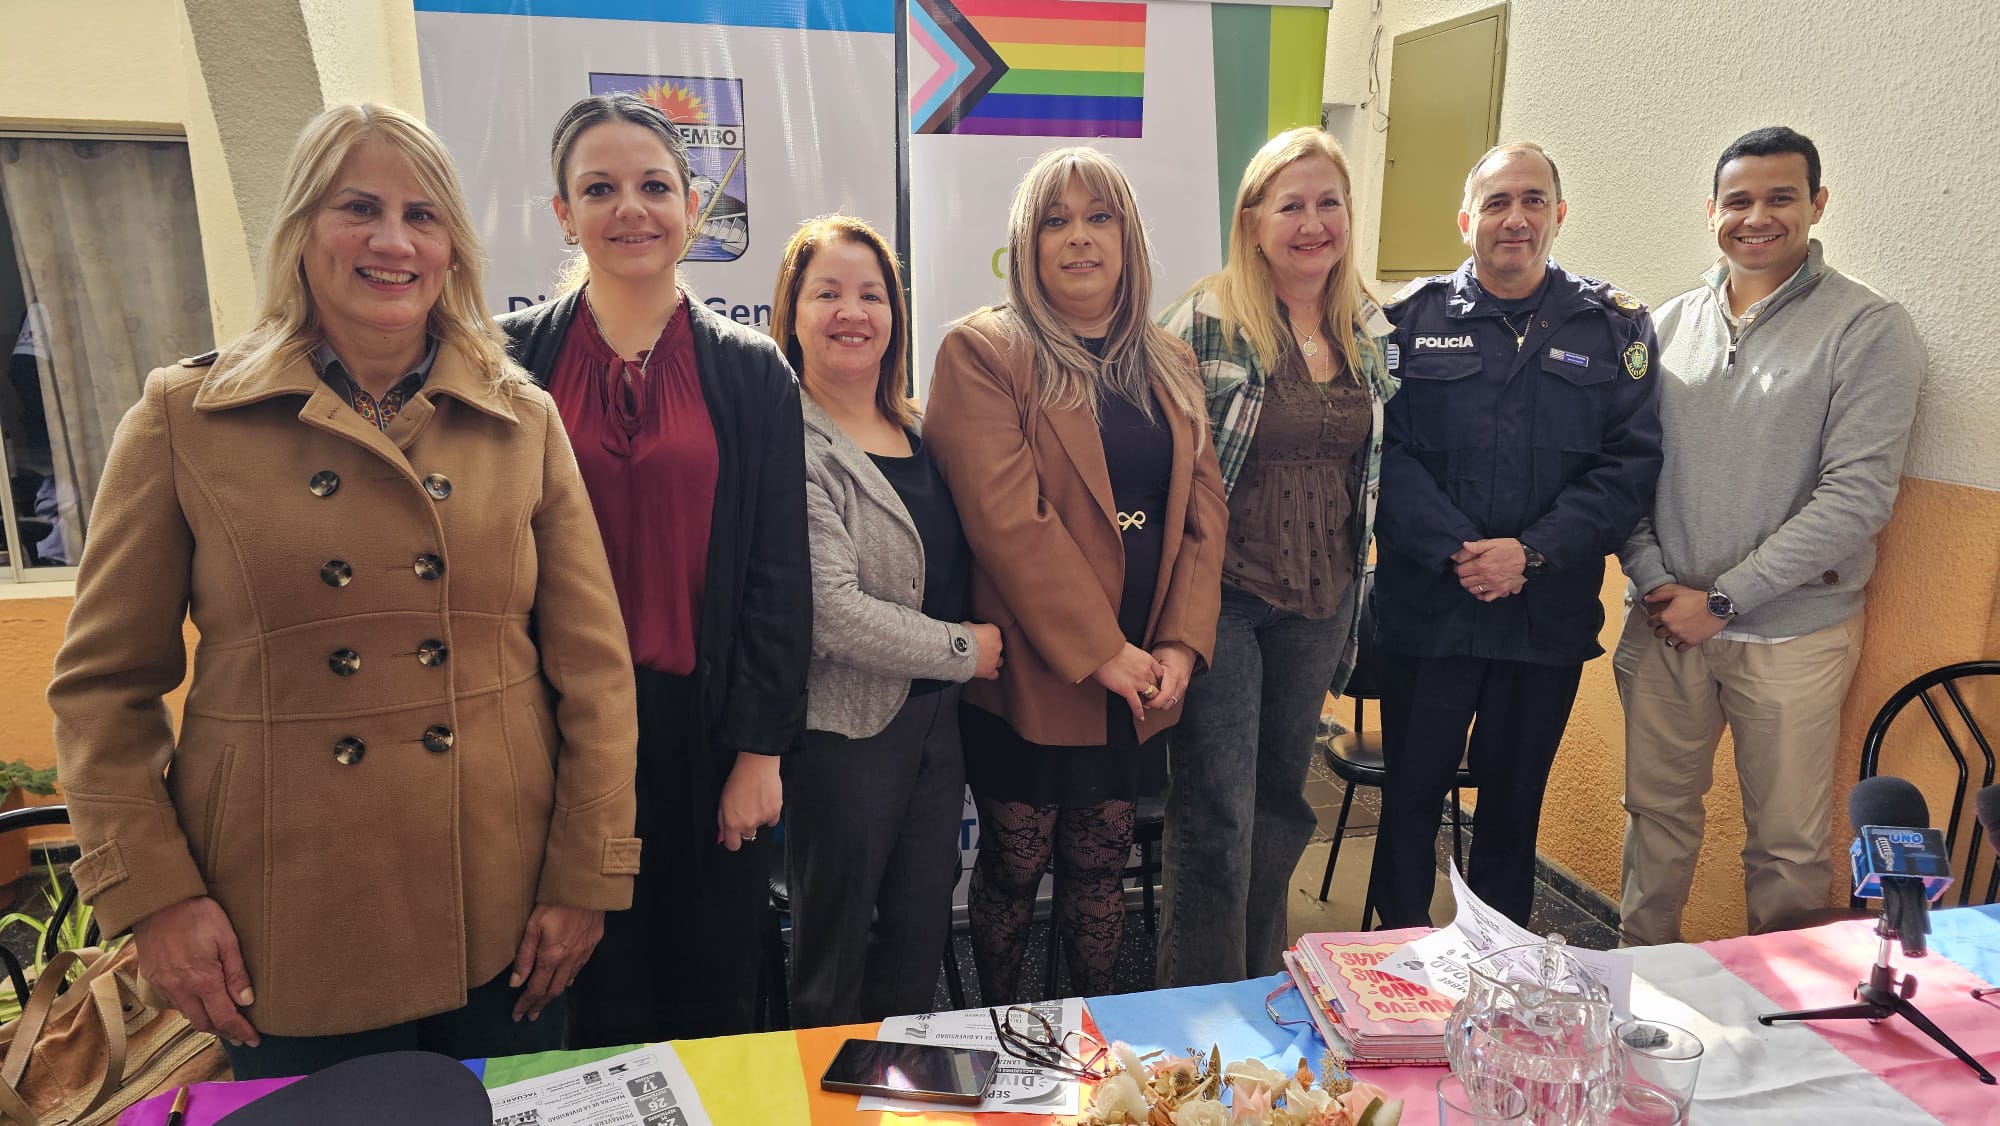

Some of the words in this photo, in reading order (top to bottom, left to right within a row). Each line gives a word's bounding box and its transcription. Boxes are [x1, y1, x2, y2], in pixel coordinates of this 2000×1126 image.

[680, 128, 737, 146] EMBO
[704, 297, 773, 327] Gen
[1415, 336, 1474, 349] POLICIA
[1889, 832, 1923, 845] UNO
[1340, 951, 1390, 967] GLAS
[1430, 960, 1469, 980] DAD
[1437, 976, 1468, 993] MBRE
[1374, 999, 1456, 1014] NUEVO
[935, 1032, 974, 1041] DIVERSIDAD
[642, 1081, 658, 1094] 17
[990, 1074, 1035, 1088] DIV
[600, 1094, 626, 1105] MARCHA
[985, 1090, 1011, 1099] SEP
[648, 1097, 668, 1112] 26
[547, 1107, 583, 1123] DIVERSIDAD
